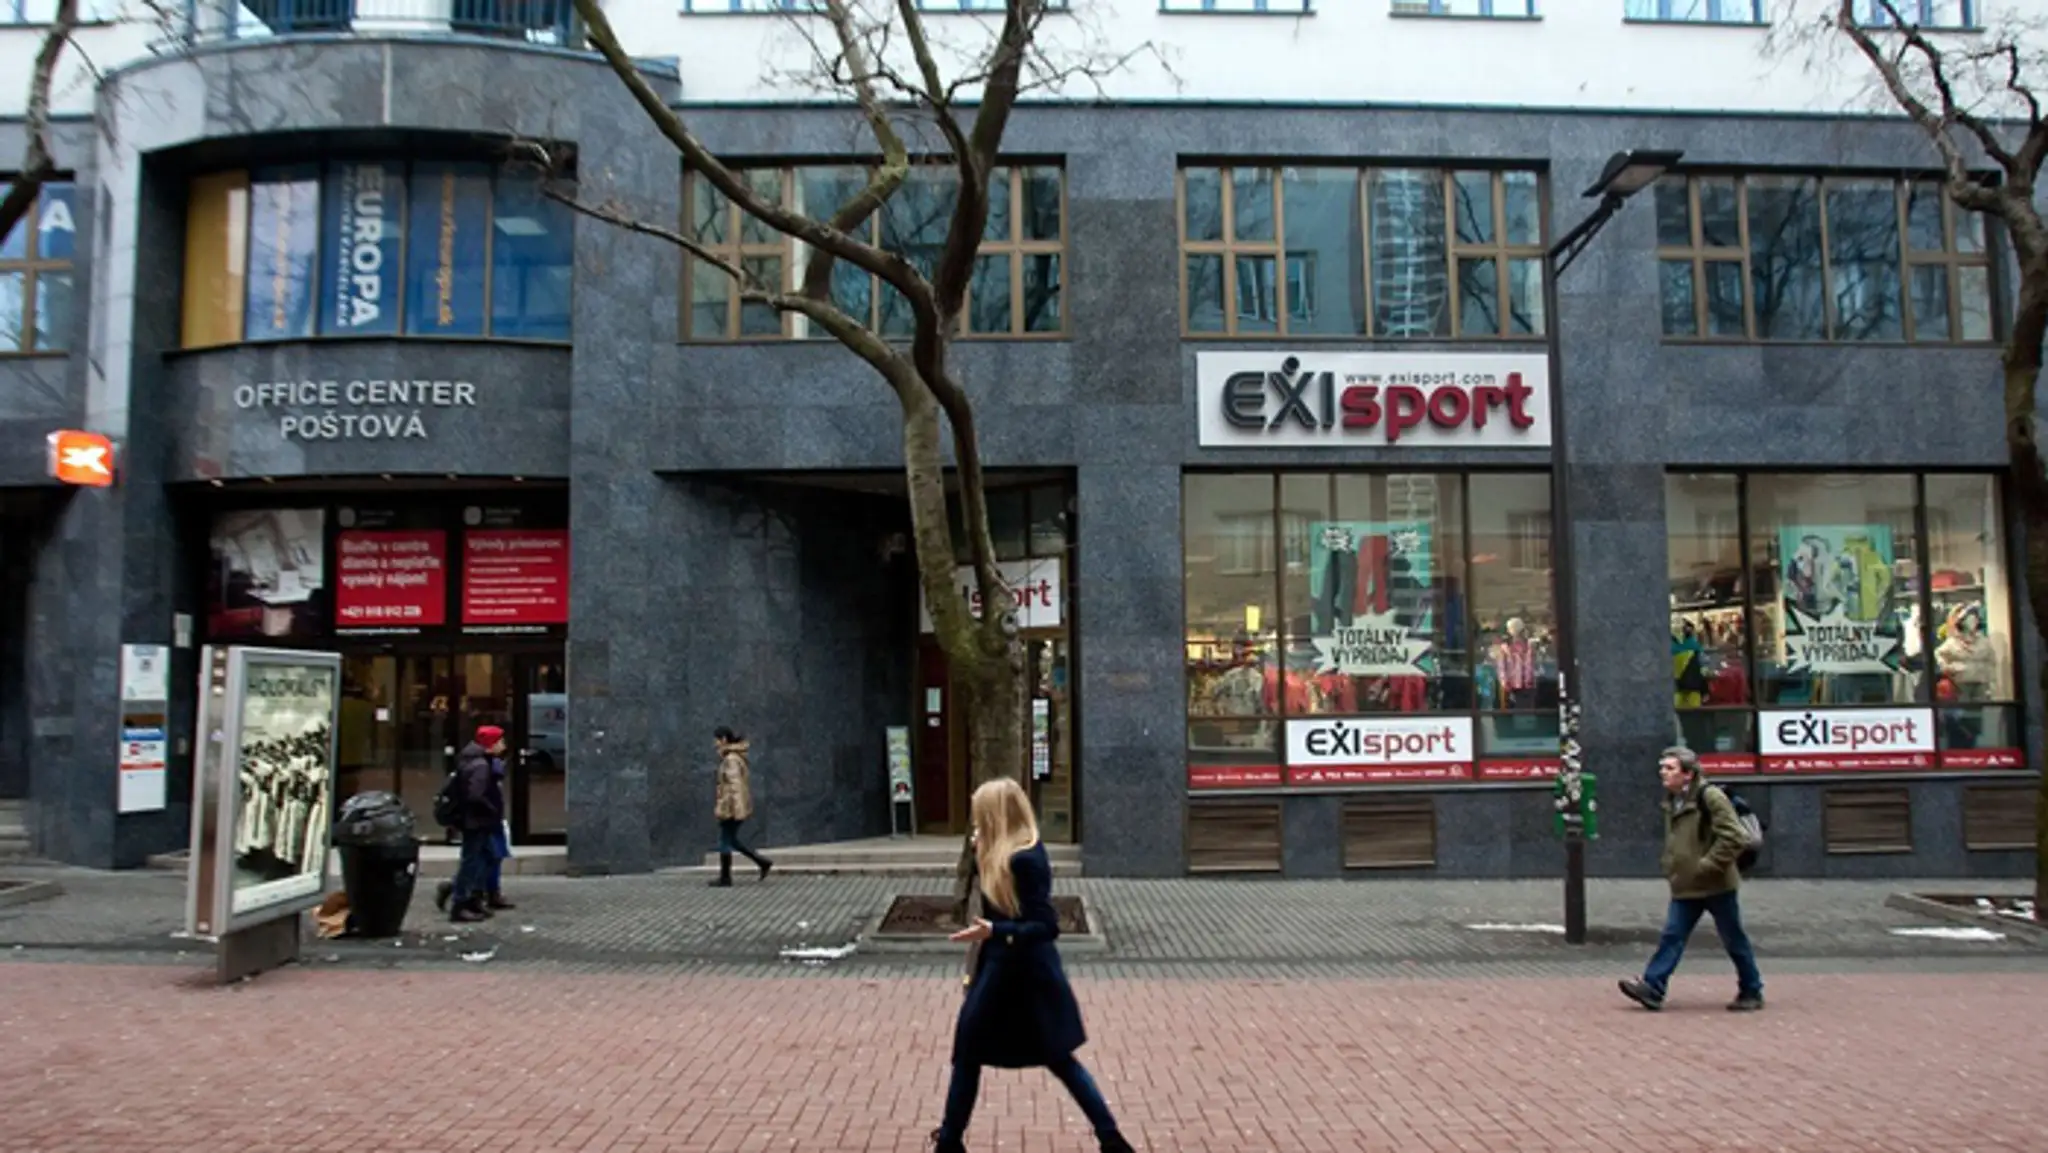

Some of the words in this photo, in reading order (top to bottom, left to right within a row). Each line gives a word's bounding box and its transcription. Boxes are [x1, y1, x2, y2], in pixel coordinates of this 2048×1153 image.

[350, 165, 384, 327] EUROPA
[234, 380, 339, 408] OFFICE
[346, 380, 476, 405] CENTER
[1344, 371, 1496, 385] www.exisport.com
[1220, 356, 1535, 443] EXIsport
[280, 411, 427, 440] POŠTOVÁ
[1306, 721, 1456, 760] EXIsport
[1778, 712, 1917, 750] EXIsport
